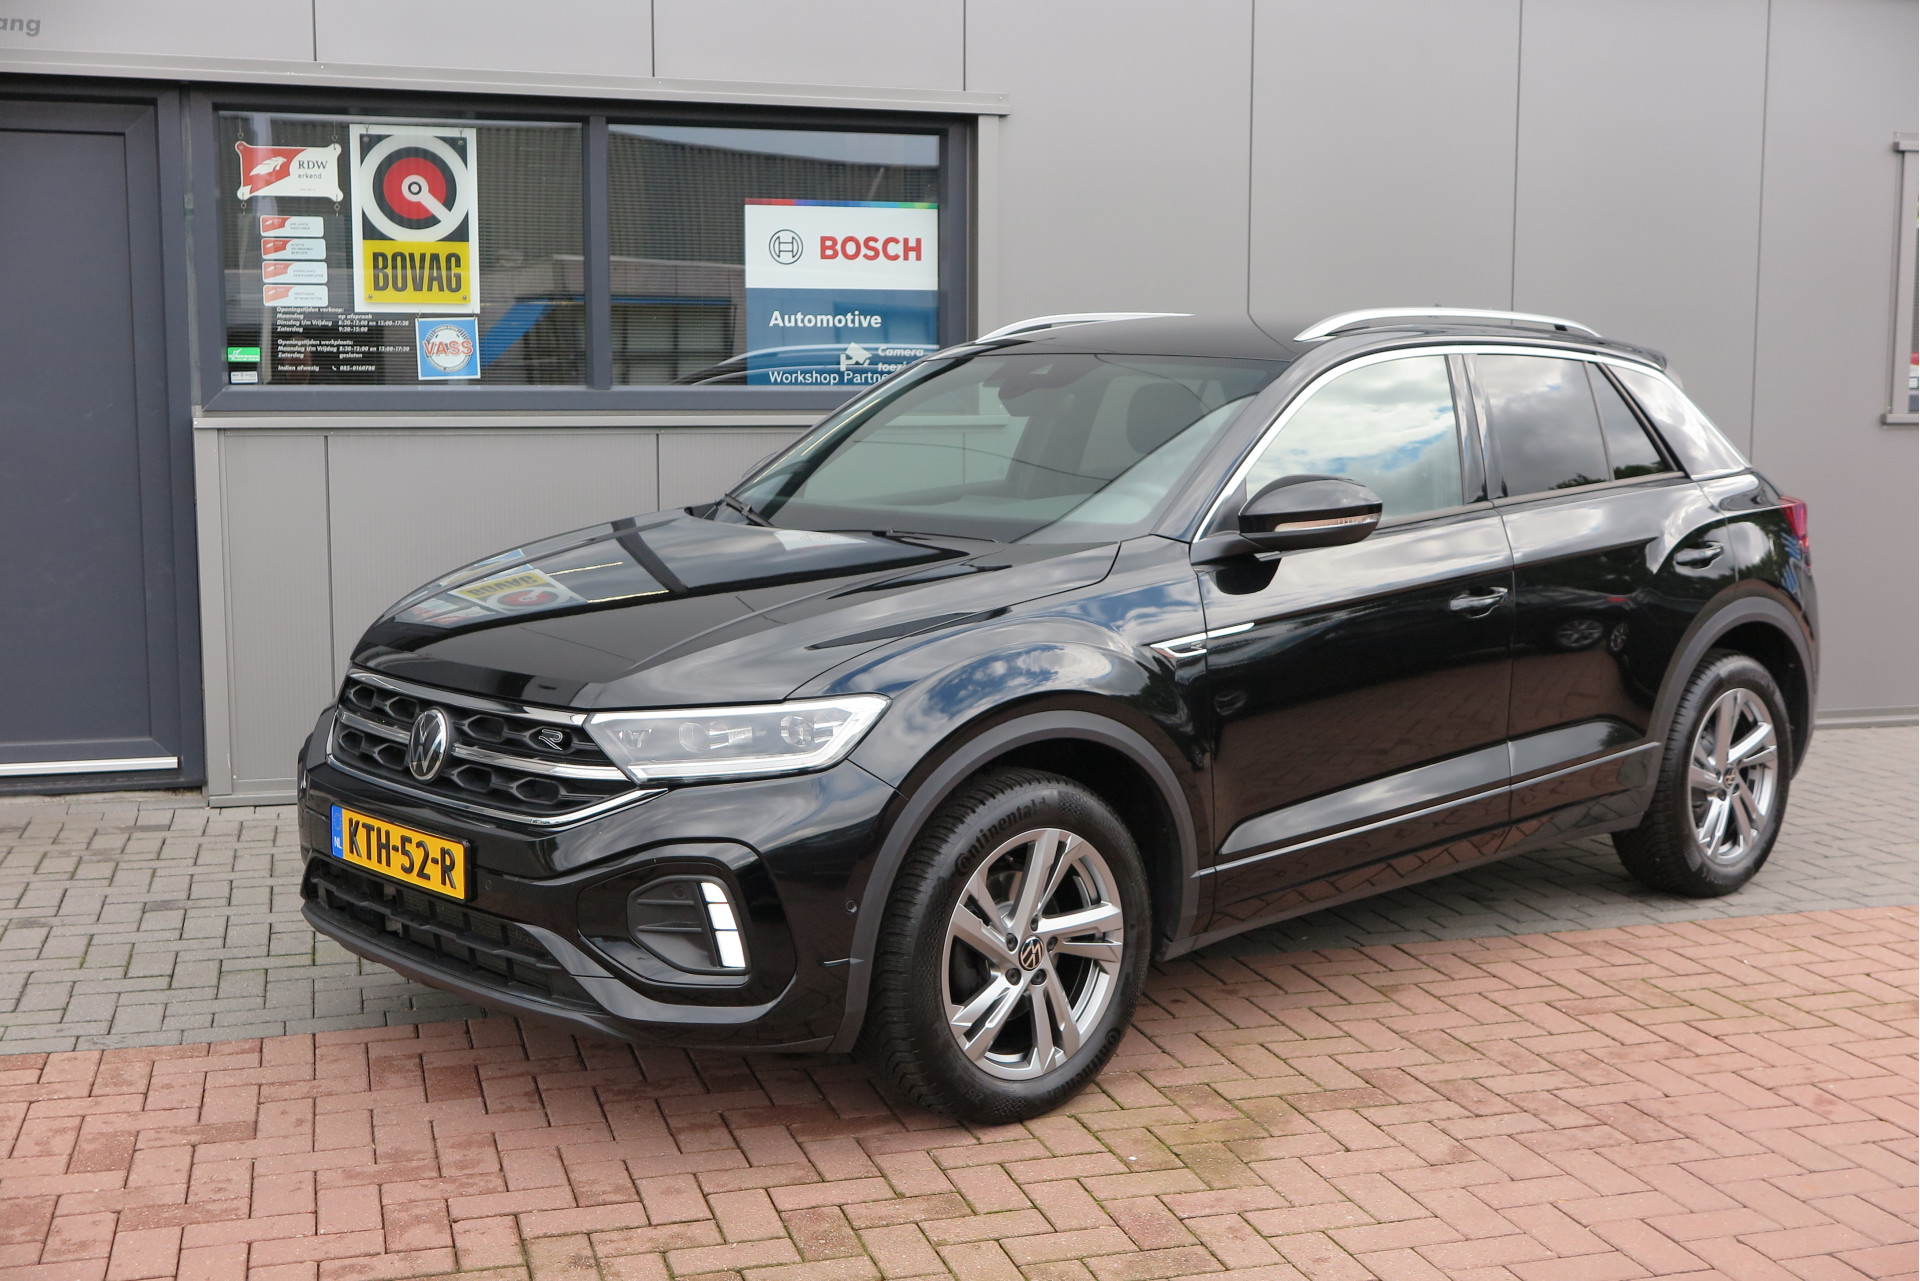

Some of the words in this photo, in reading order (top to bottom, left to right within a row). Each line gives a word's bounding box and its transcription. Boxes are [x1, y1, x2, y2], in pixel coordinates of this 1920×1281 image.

[298, 160, 328, 170] RDW
[819, 235, 922, 262] BOSCH
[372, 251, 462, 293] BOVAG
[769, 310, 882, 328] Automotive
[422, 339, 474, 357] VASS
[877, 346, 925, 357] Camera
[768, 370, 839, 386] Workshop
[333, 836, 343, 850] NL
[954, 799, 1038, 877] Continental
[347, 816, 457, 890] KTH-52-R
